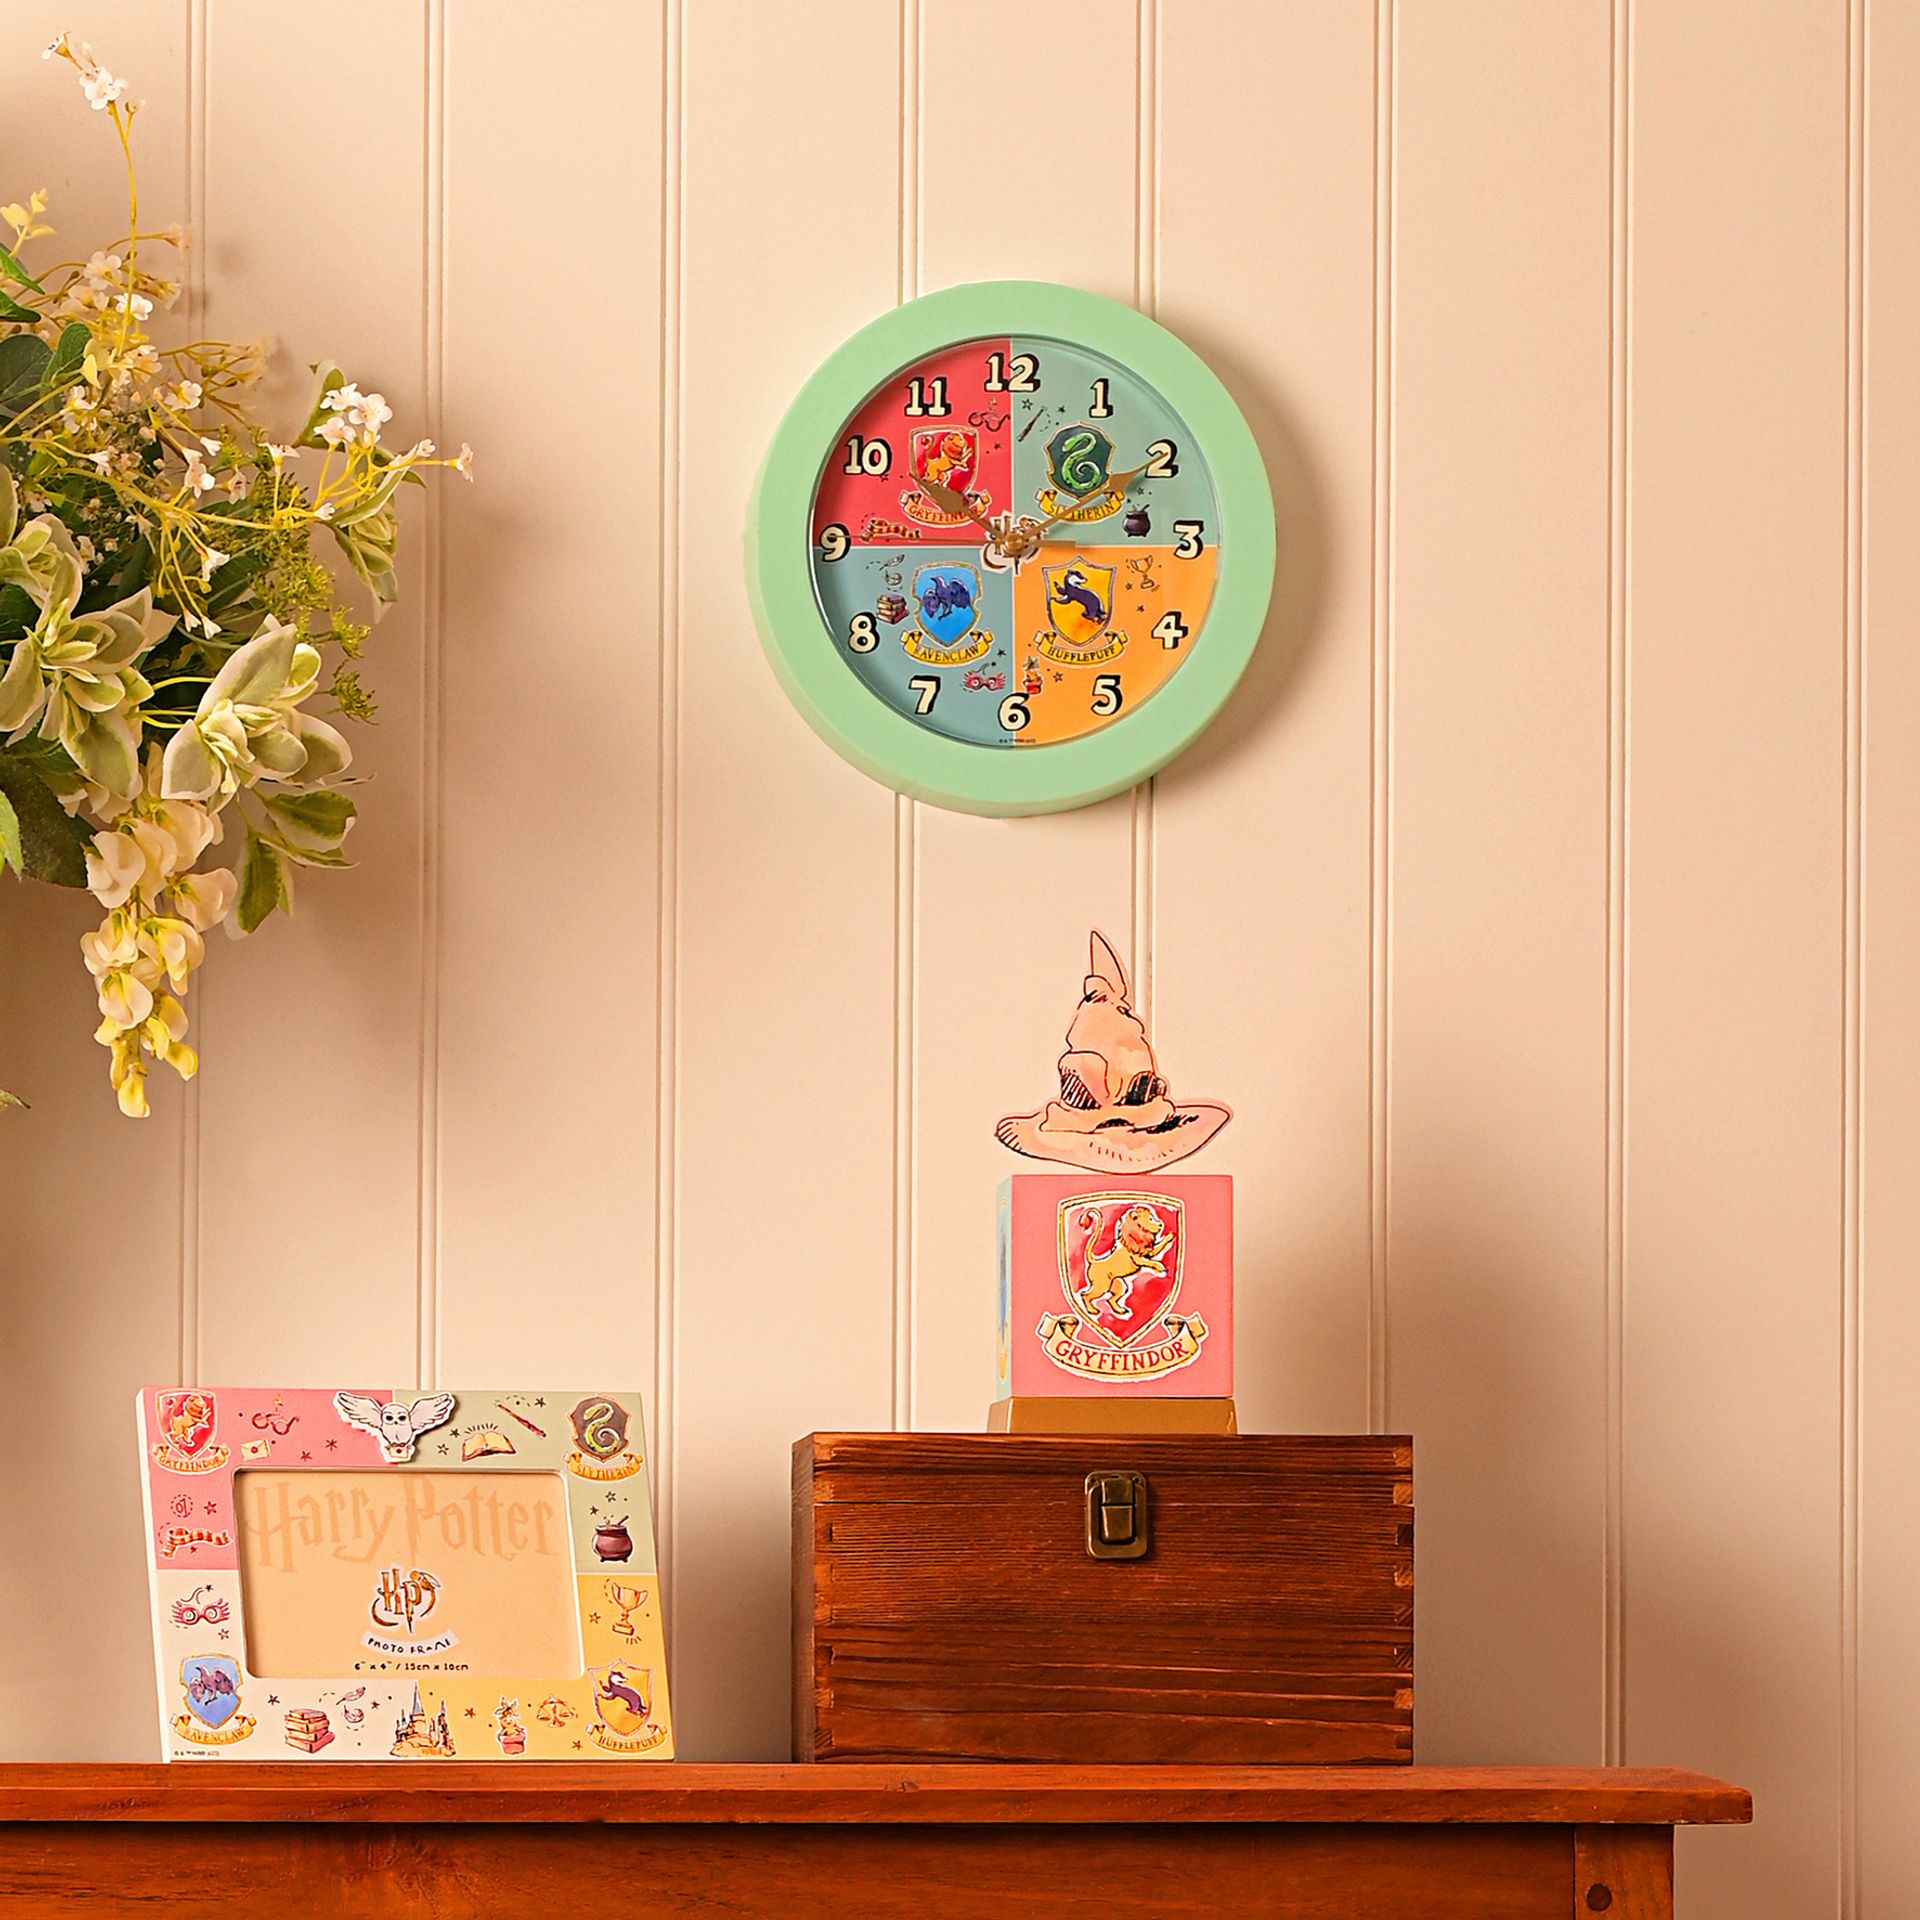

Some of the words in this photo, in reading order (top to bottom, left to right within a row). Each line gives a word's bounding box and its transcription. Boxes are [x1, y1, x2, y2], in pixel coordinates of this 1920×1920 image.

[984, 352, 1040, 393] 12
[905, 376, 952, 417] 11
[1089, 378, 1114, 419] 1
[843, 434, 892, 476] 10
[1145, 439, 1179, 479] 2
[909, 504, 979, 522] GRYFFINDR
[1049, 502, 1115, 520] SLTHERIN
[819, 523, 852, 563] 9
[1173, 520, 1205, 560] 3
[848, 611, 880, 654] 8
[1151, 611, 1189, 650] 4
[1047, 646, 1117, 662] HUFFLEPUFF
[908, 675, 941, 715] 7
[998, 692, 1031, 731] 6
[1090, 674, 1123, 716] 5
[1055, 1340, 1189, 1371] GRYFFINDOR
[246, 1482, 395, 1574] Harry
[402, 1473, 555, 1566] Potter
[367, 1637, 405, 1653] PHOTO
[410, 1638, 451, 1654] FRAME
